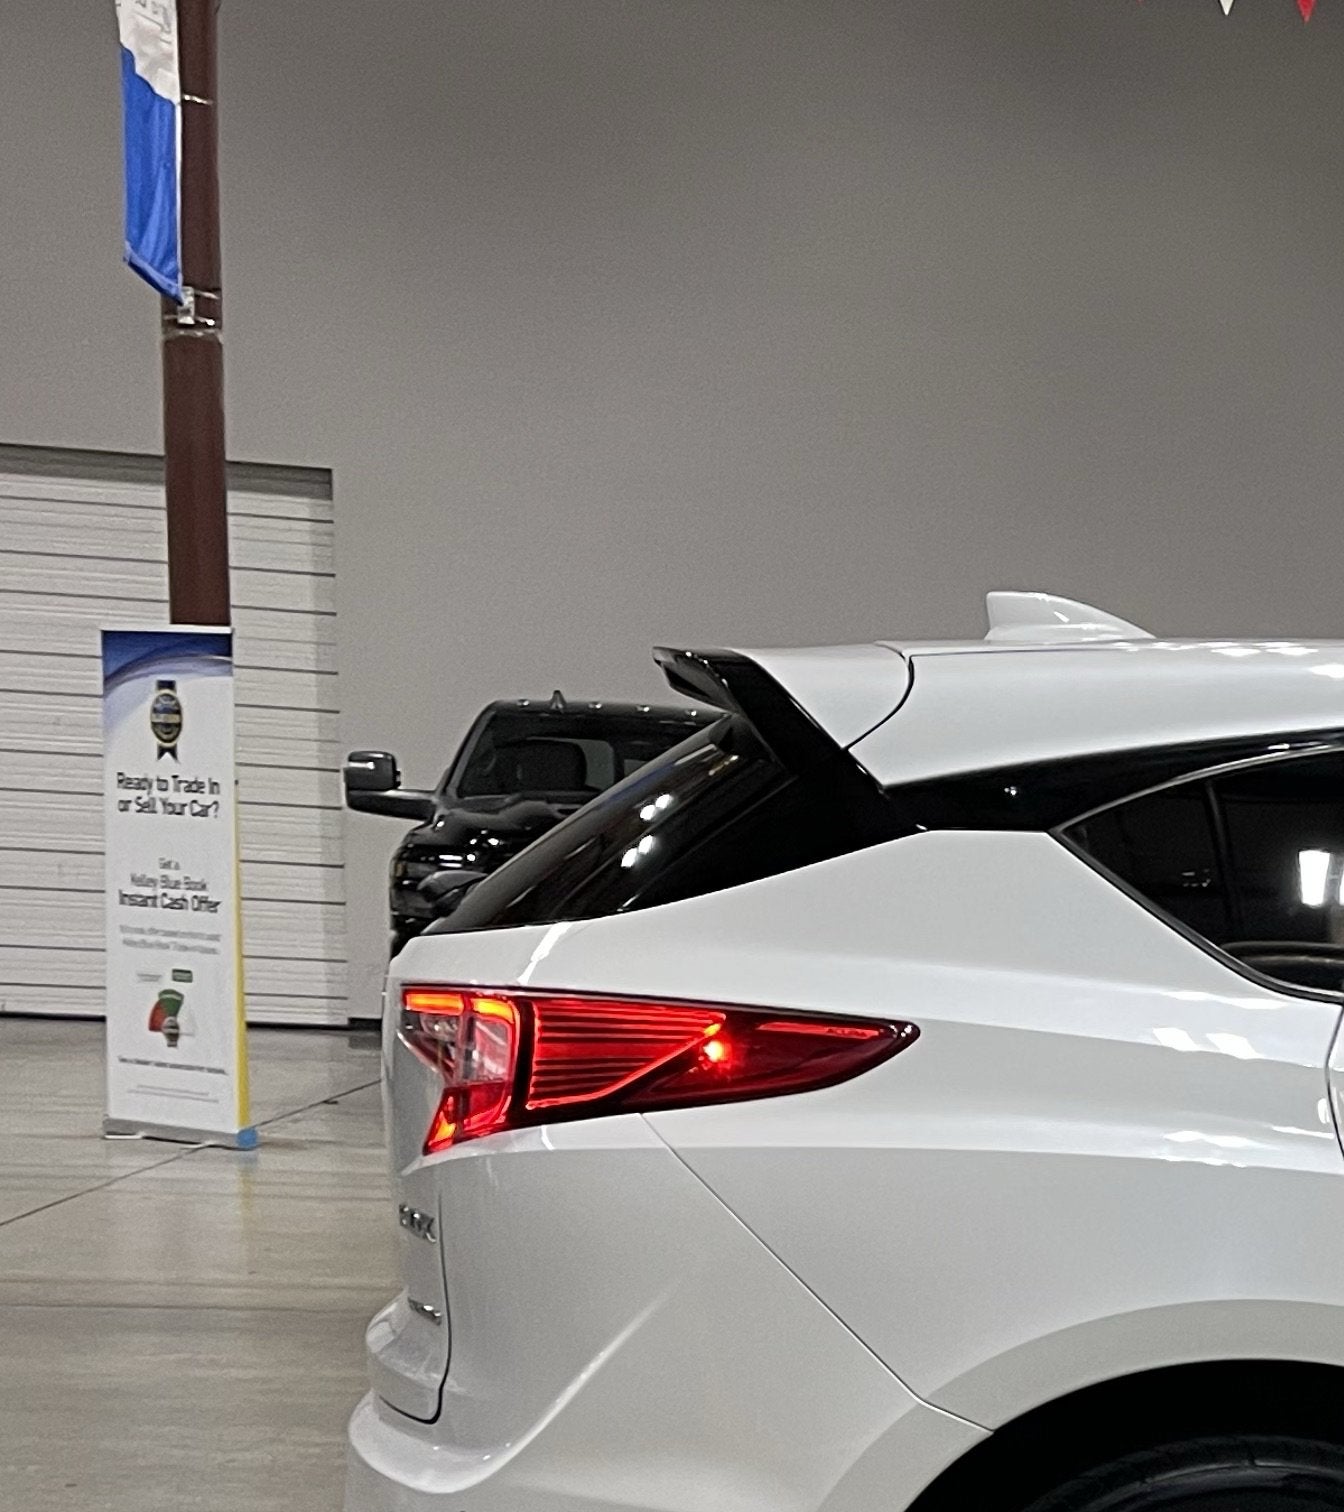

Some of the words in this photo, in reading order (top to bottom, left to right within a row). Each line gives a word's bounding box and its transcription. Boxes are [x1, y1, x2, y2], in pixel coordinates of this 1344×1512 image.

[117, 771, 153, 796] Ready
[156, 775, 169, 792] to
[171, 775, 206, 794] Trade
[208, 777, 221, 795] In
[117, 799, 132, 812] or
[135, 796, 158, 814] Sell
[159, 798, 188, 816] Your
[189, 799, 220, 819] Car?
[118, 889, 158, 909] Instant
[161, 892, 189, 911] Cash
[191, 895, 222, 914] Offer
